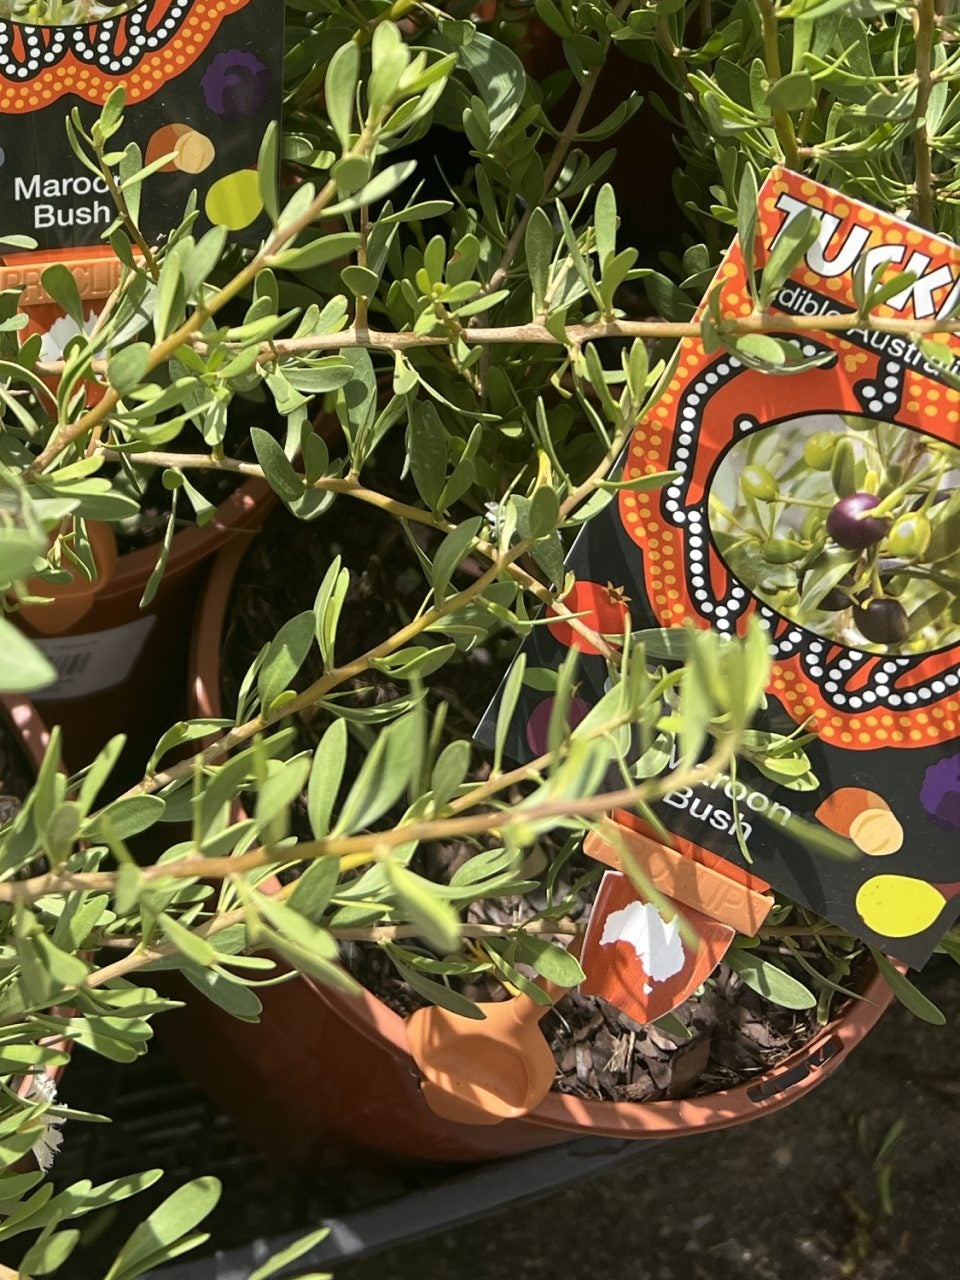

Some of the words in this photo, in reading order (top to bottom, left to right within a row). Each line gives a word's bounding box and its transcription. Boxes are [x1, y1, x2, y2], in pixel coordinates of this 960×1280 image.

[14, 174, 121, 201] Maroo
[34, 200, 111, 229] Bush
[769, 192, 960, 322] TUCK
[662, 786, 753, 842] Bush
